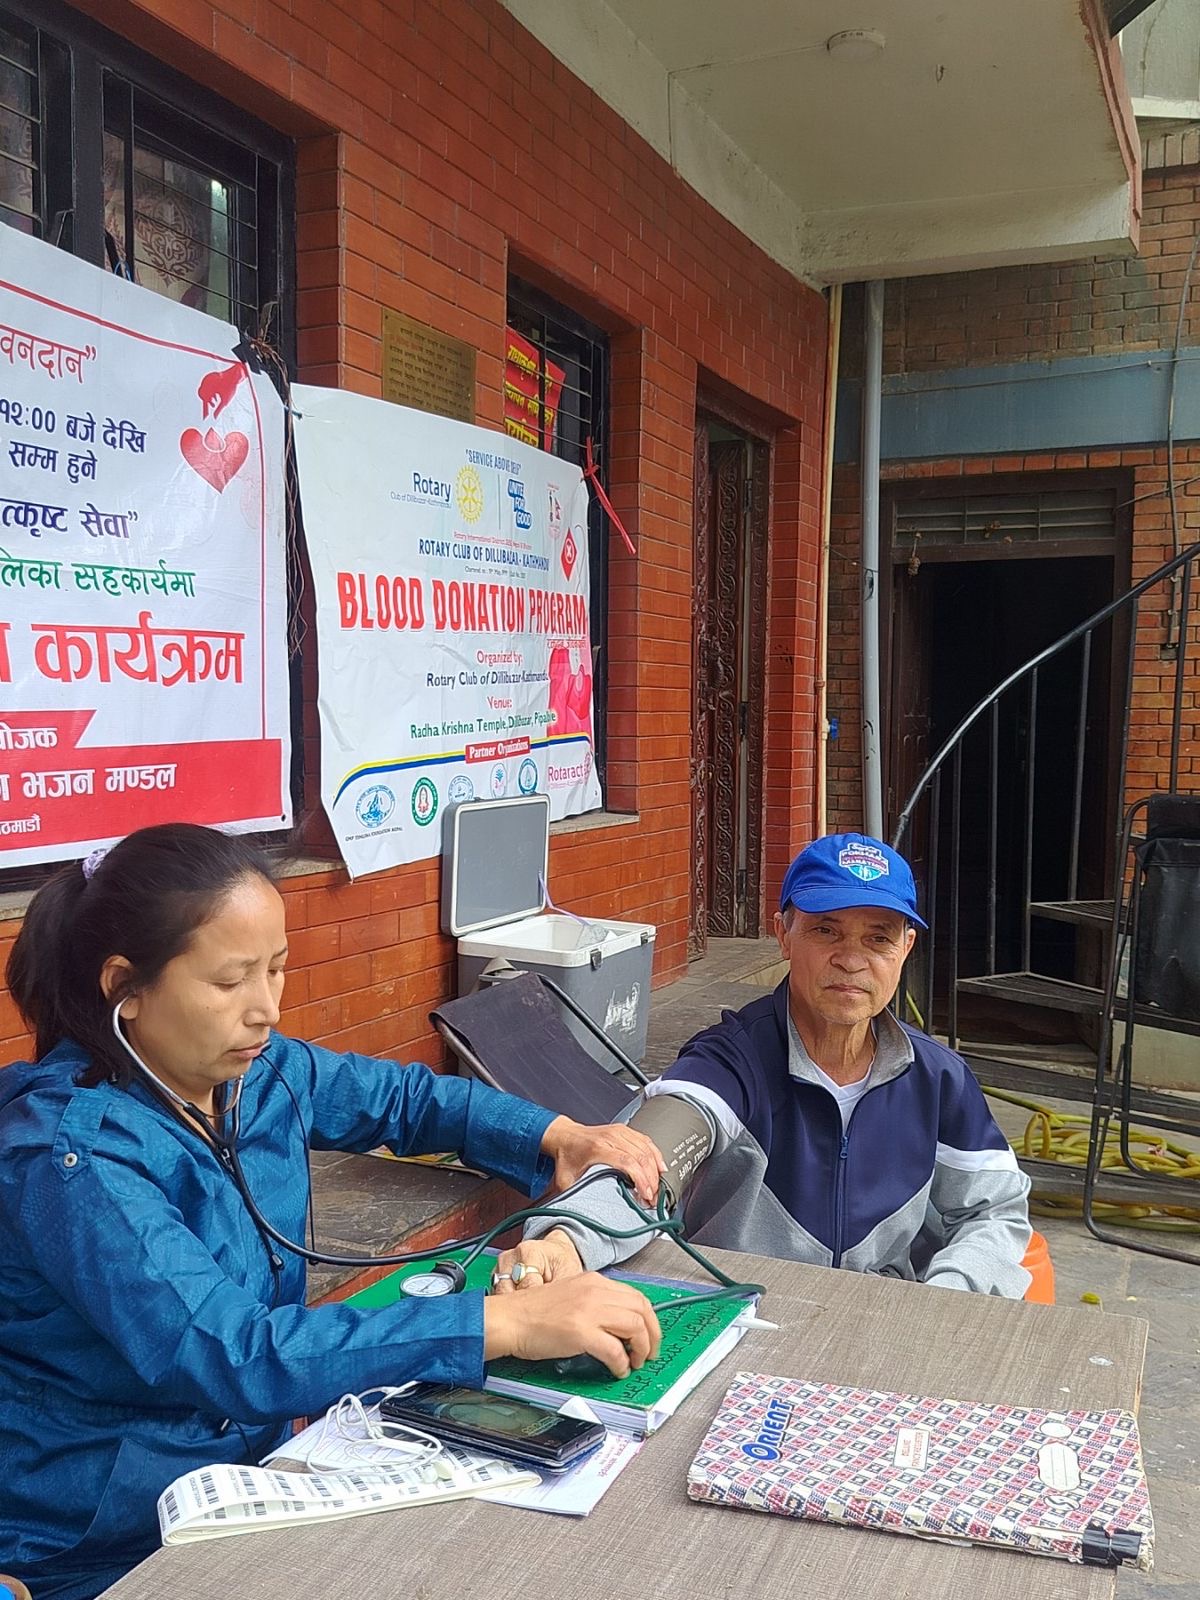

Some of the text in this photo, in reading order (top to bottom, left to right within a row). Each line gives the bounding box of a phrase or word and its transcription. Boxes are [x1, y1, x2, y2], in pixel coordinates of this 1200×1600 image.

[66, 412, 97, 443] बजे
[102, 417, 147, 453] देखि
[8, 440, 98, 483] सम्म हुने
[413, 473, 451, 503] Rotary
[79, 502, 139, 538] सेवा”
[517, 511, 532, 527] GOOD
[419, 539, 450, 557] ROTARY
[453, 544, 471, 560] CLUB
[473, 546, 483, 561] OF
[71, 559, 196, 598] सहकार्यमा
[337, 572, 587, 635] BLOOD DONATION PROGRAM
[31, 611, 245, 687] कार्यक्रम
[477, 650, 513, 667] Organized
[427, 672, 456, 689] Rotary
[459, 671, 477, 686] Club
[480, 671, 490, 685] of
[487, 696, 512, 710] Venue:
[410, 724, 440, 739] Radha
[441, 720, 474, 736] Krishna
[469, 744, 497, 760] Partner
[21, 768, 95, 799] भजन
[104, 764, 178, 793] मण्डल
[548, 764, 583, 783] Rotaract
[679, 1160, 692, 1180] CUFF
[741, 1397, 793, 1461] ORIENT
